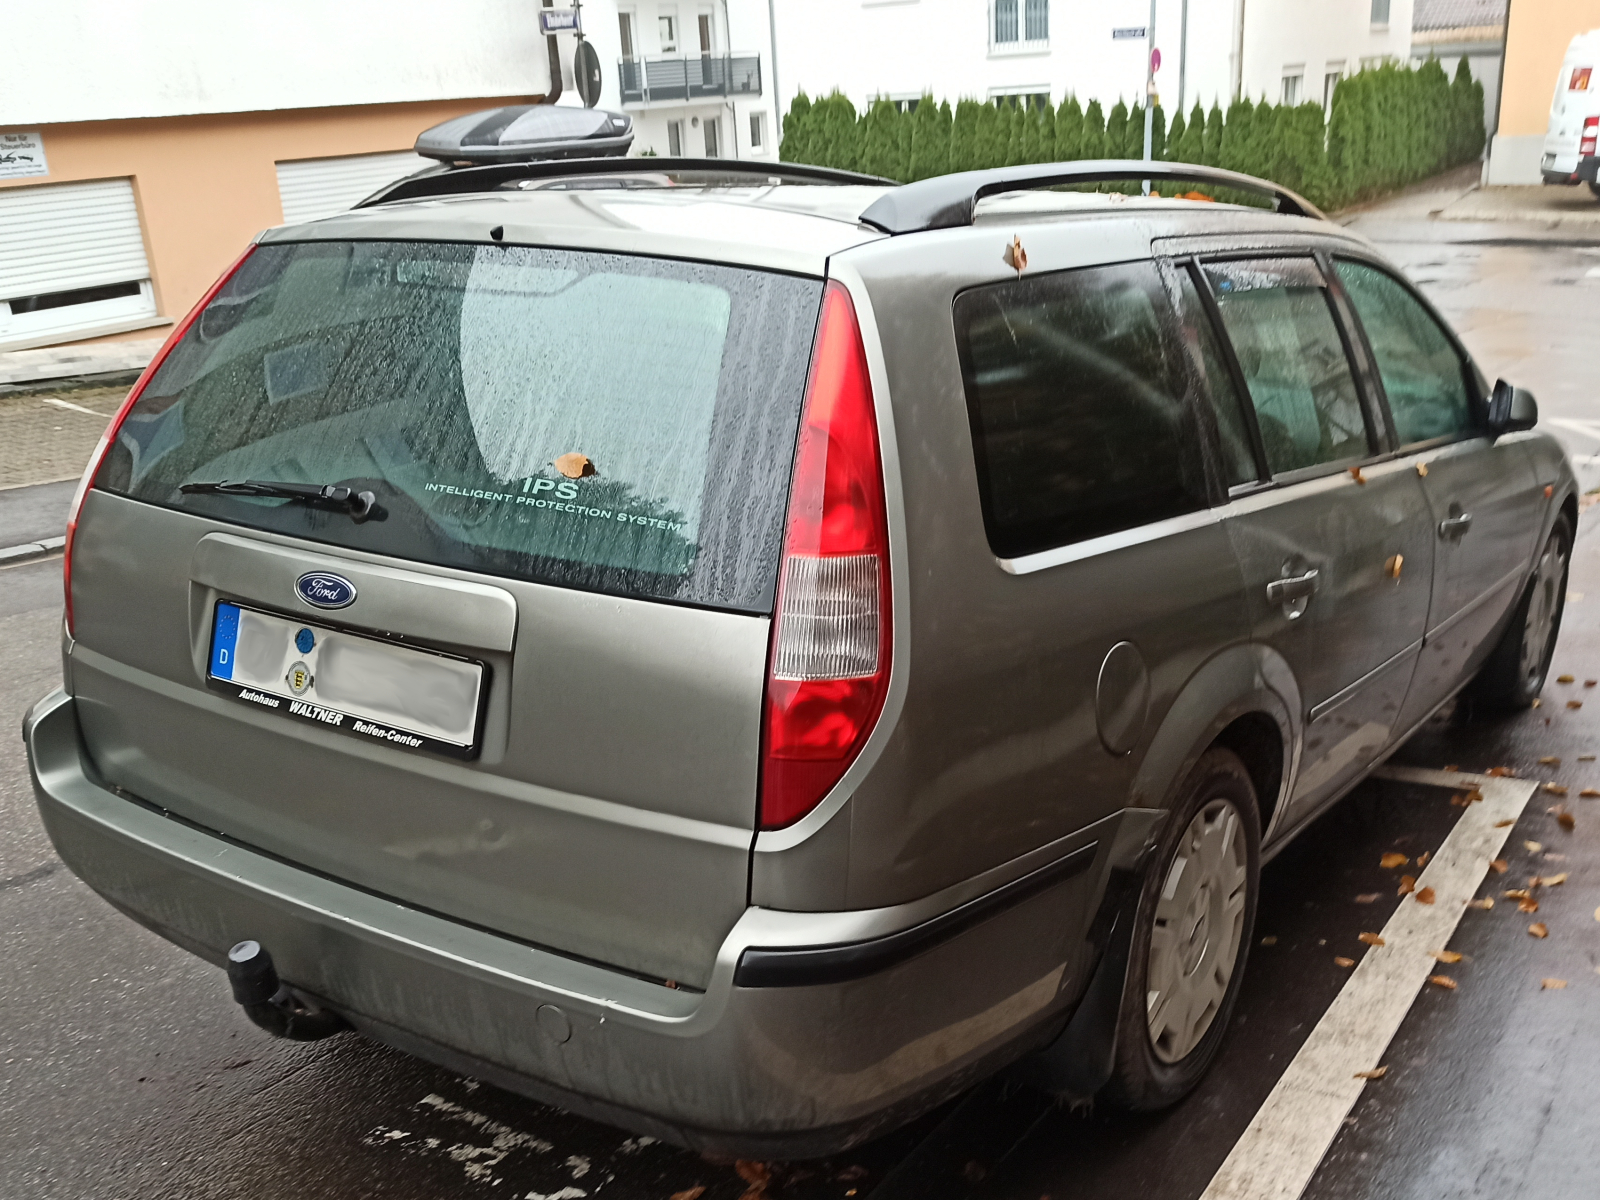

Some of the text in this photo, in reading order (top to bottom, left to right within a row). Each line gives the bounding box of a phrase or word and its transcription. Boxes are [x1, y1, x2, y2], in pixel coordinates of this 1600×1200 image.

[522, 477, 579, 499] IPS
[424, 483, 682, 532] INTELLIGENT PROTECTION SYSTEM
[307, 579, 339, 600] Ford
[219, 648, 229, 664] D
[239, 689, 422, 748] Autohaus WALTNER Reifen-Center
